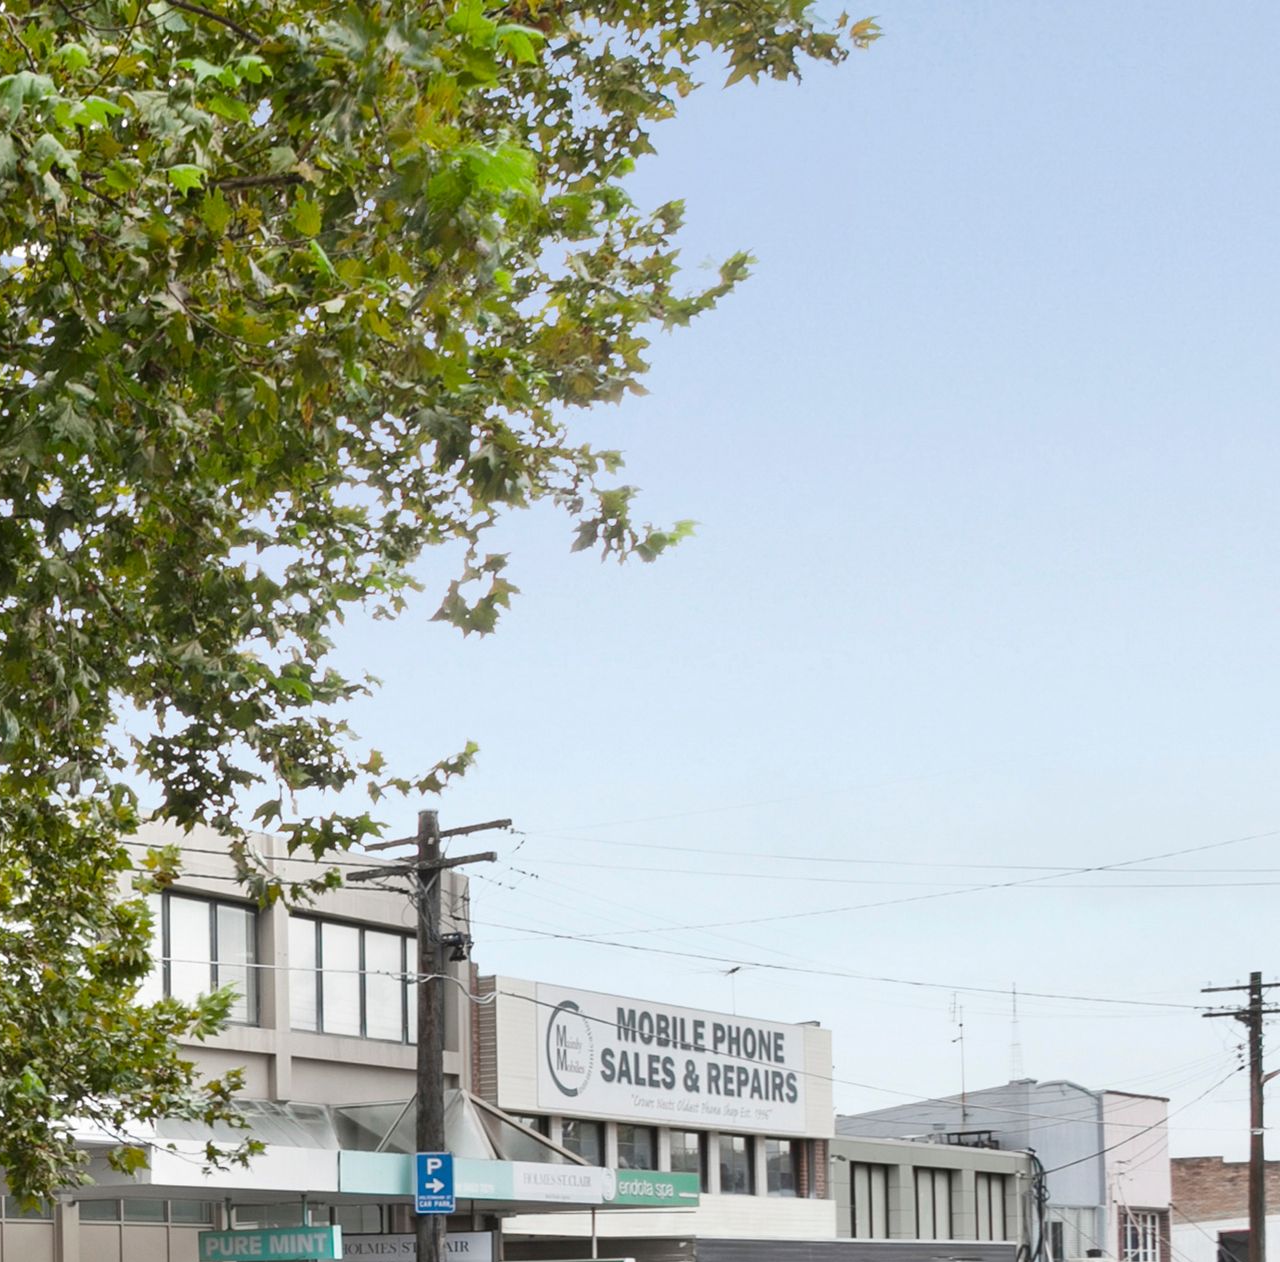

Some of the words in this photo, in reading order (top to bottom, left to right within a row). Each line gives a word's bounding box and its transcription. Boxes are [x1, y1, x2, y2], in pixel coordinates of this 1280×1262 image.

[616, 1006, 705, 1053] MOBILE
[712, 1022, 786, 1064] PHONE
[600, 1047, 676, 1091] SALES
[683, 1059, 701, 1094] &
[706, 1062, 799, 1103] REPAIRS
[426, 1158, 443, 1175] P
[618, 1179, 653, 1197] endota
[655, 1182, 674, 1200] spa
[205, 1236, 263, 1256] PURE
[269, 1233, 327, 1254] MINT
